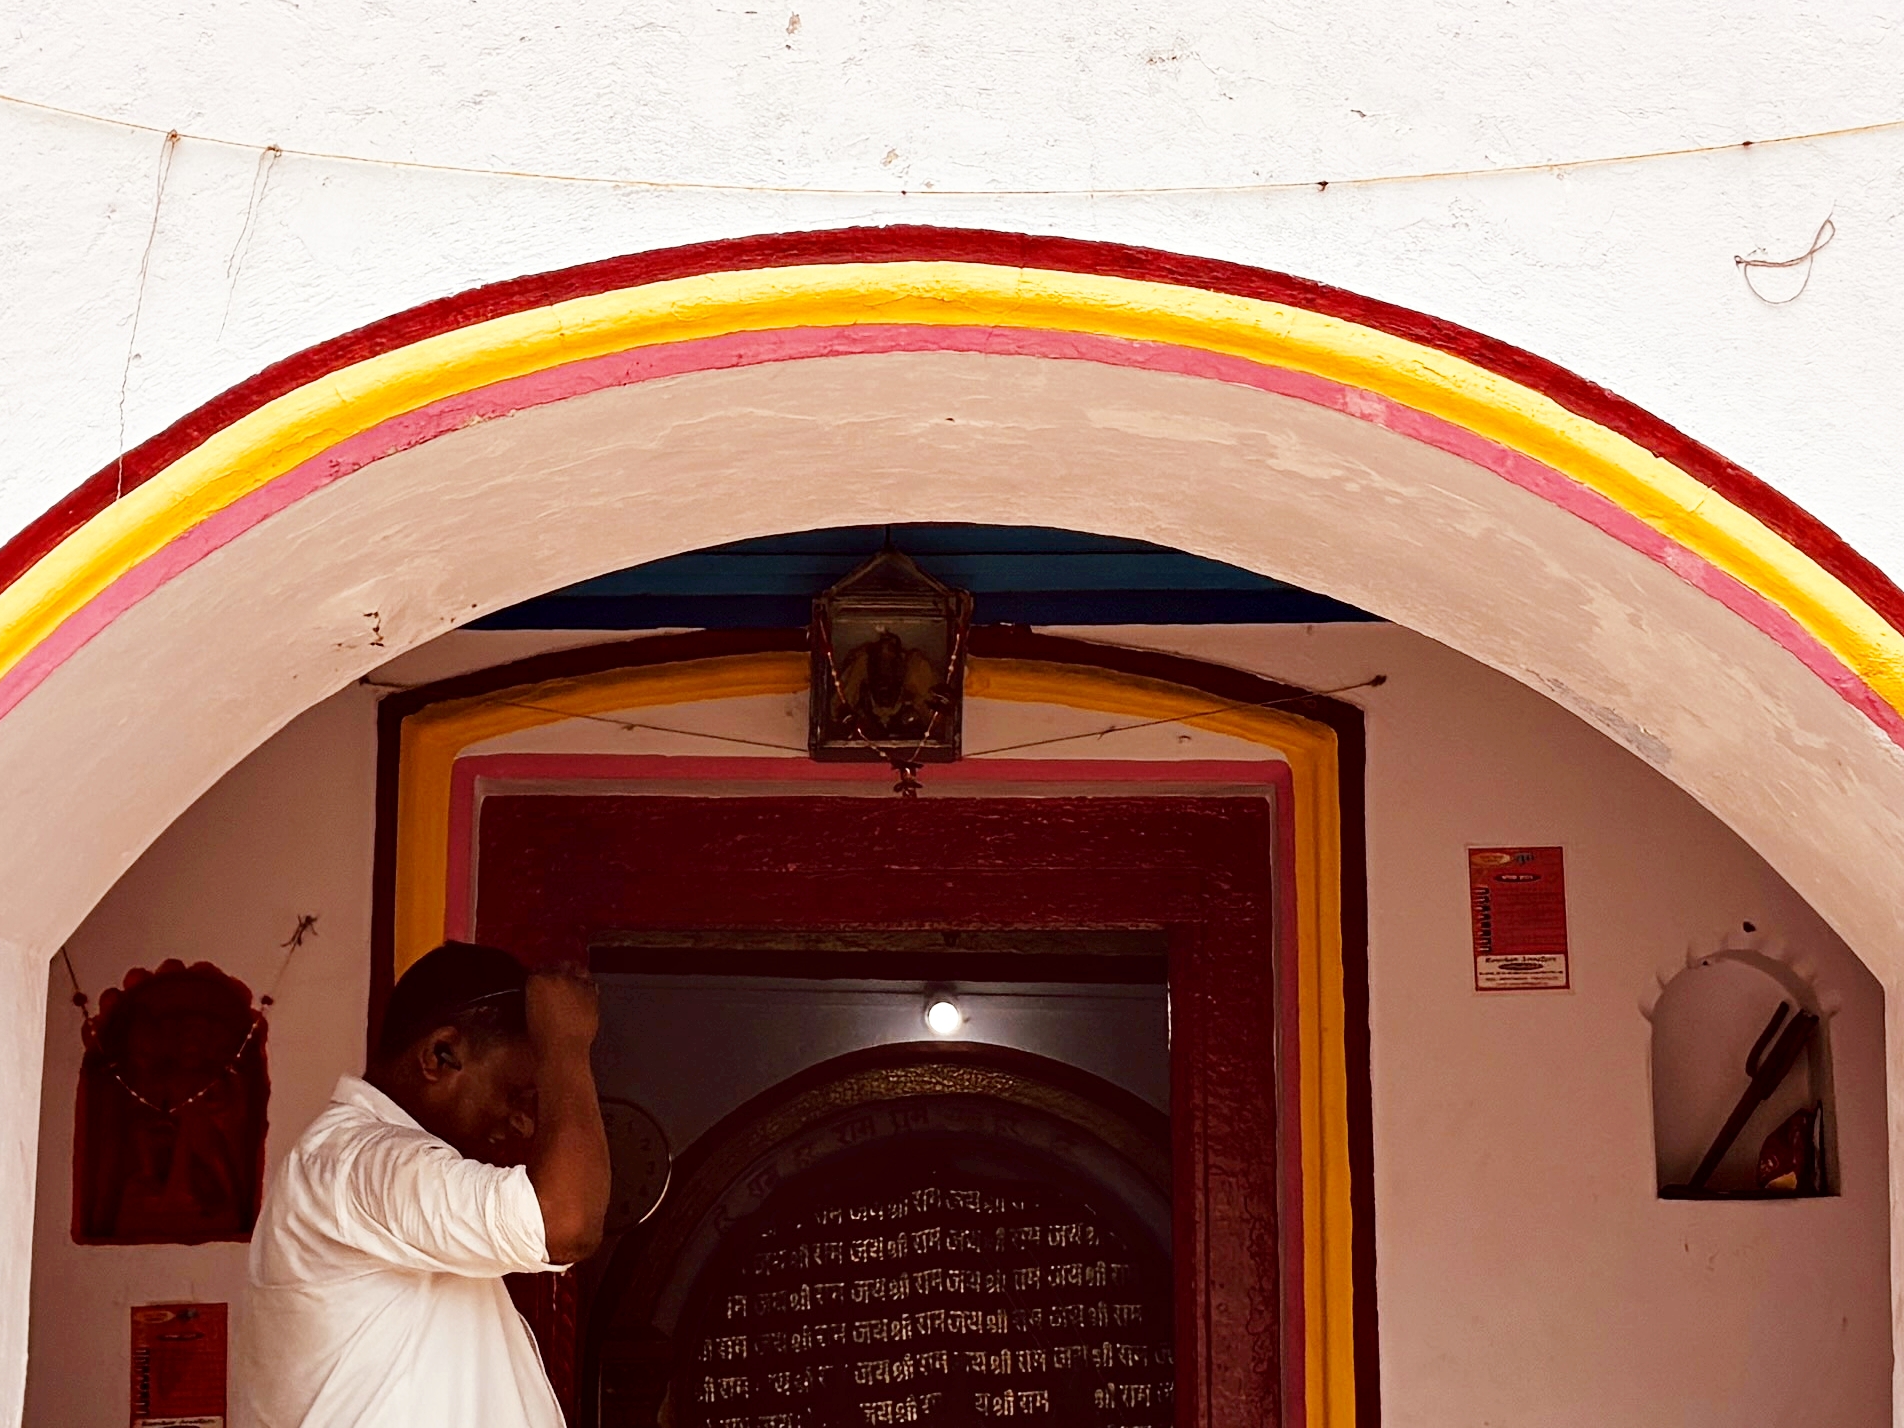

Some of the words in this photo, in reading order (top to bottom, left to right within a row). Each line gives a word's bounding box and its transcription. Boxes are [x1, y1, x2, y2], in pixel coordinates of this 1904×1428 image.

[852, 1319, 888, 1344] जय
[915, 1309, 945, 1335] राम
[947, 1310, 983, 1334] जय
[854, 1359, 890, 1385] जय
[990, 1348, 1011, 1375] श्री
[993, 1389, 1014, 1416] श्री
[1017, 1390, 1049, 1414] राम
[1119, 1384, 1151, 1408] राम
